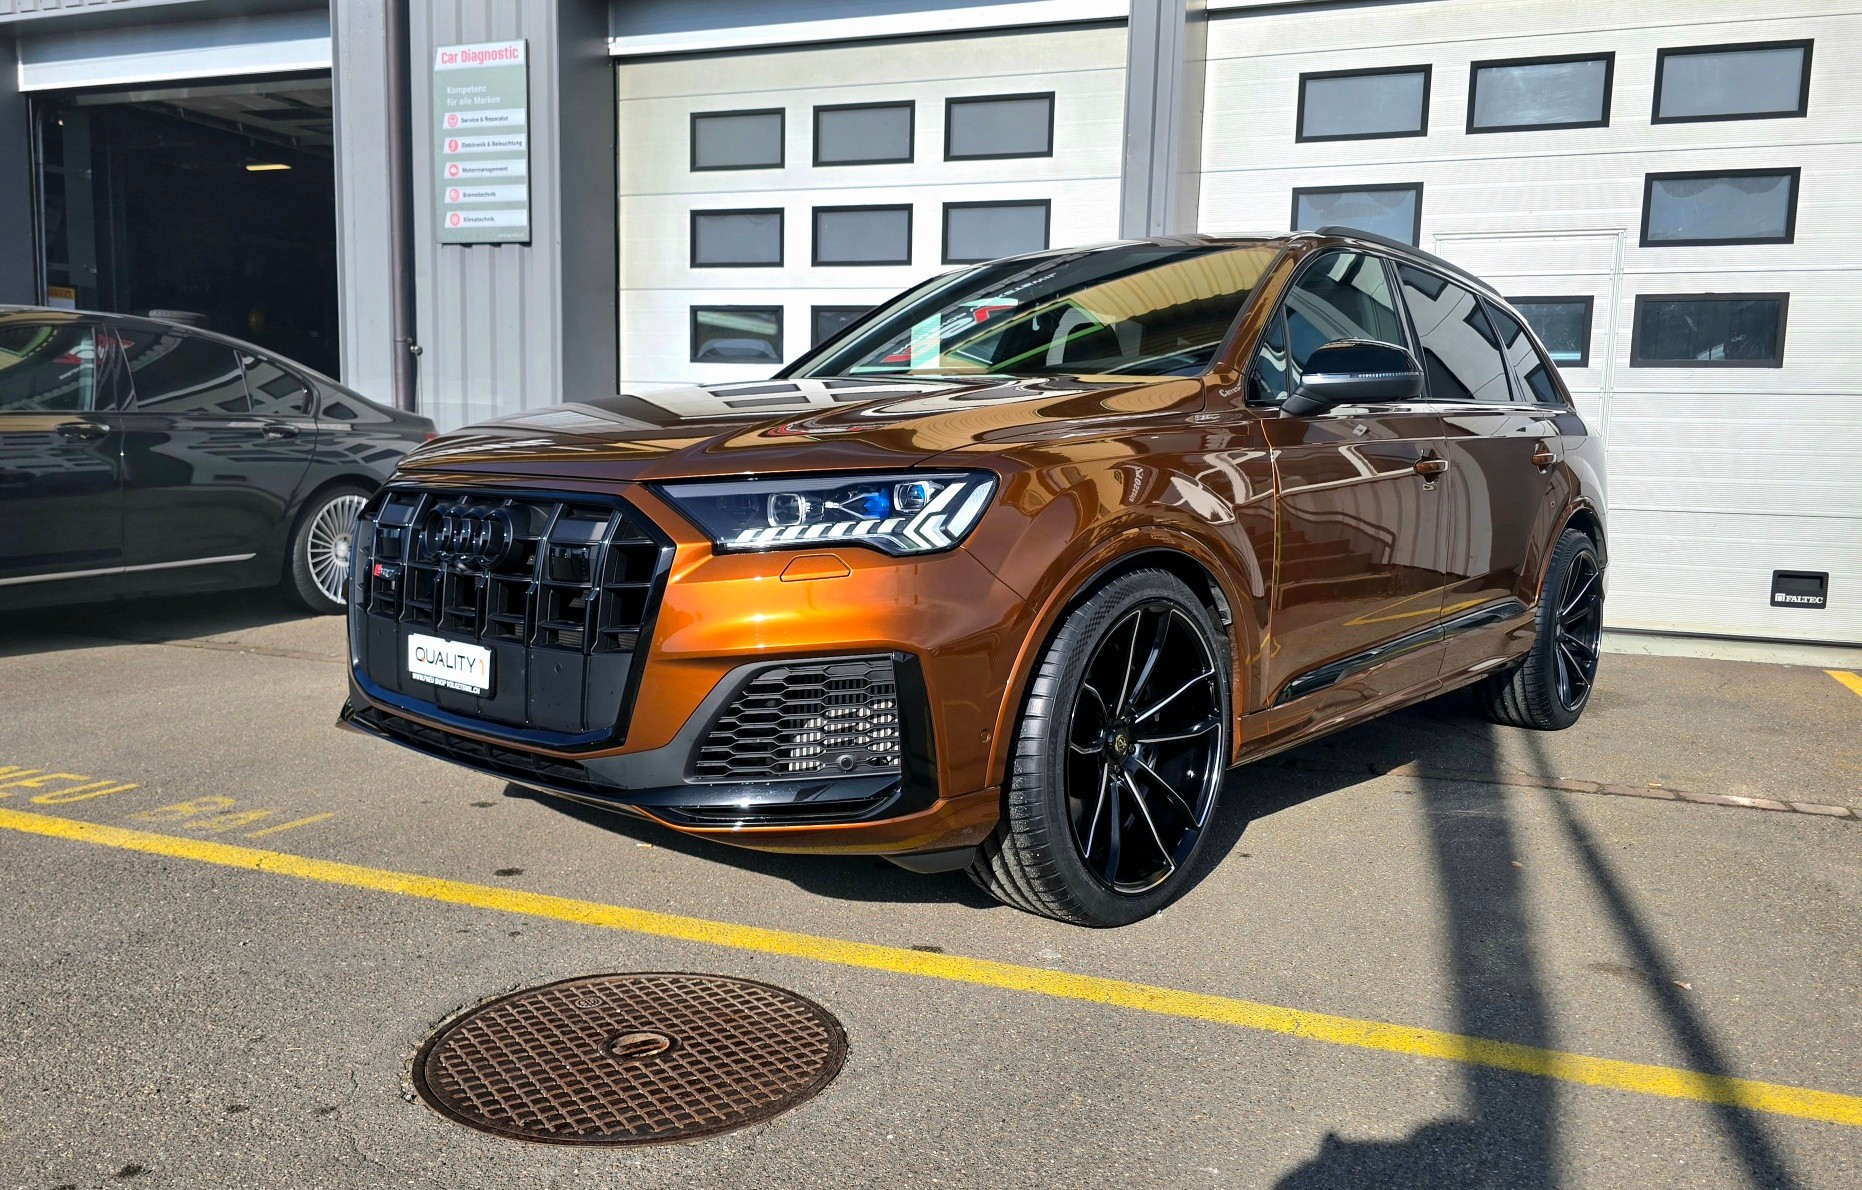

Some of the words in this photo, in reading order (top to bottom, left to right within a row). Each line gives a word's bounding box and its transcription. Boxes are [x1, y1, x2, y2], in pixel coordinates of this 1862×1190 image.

[441, 51, 459, 65] Car
[461, 45, 519, 65] Diagnostic
[447, 85, 487, 96] Kompetenz
[447, 98, 457, 106] für
[459, 97, 472, 106] alle
[474, 96, 501, 105] Marken
[1785, 595, 1824, 604] FALTEC
[415, 646, 476, 673] QUALITY
